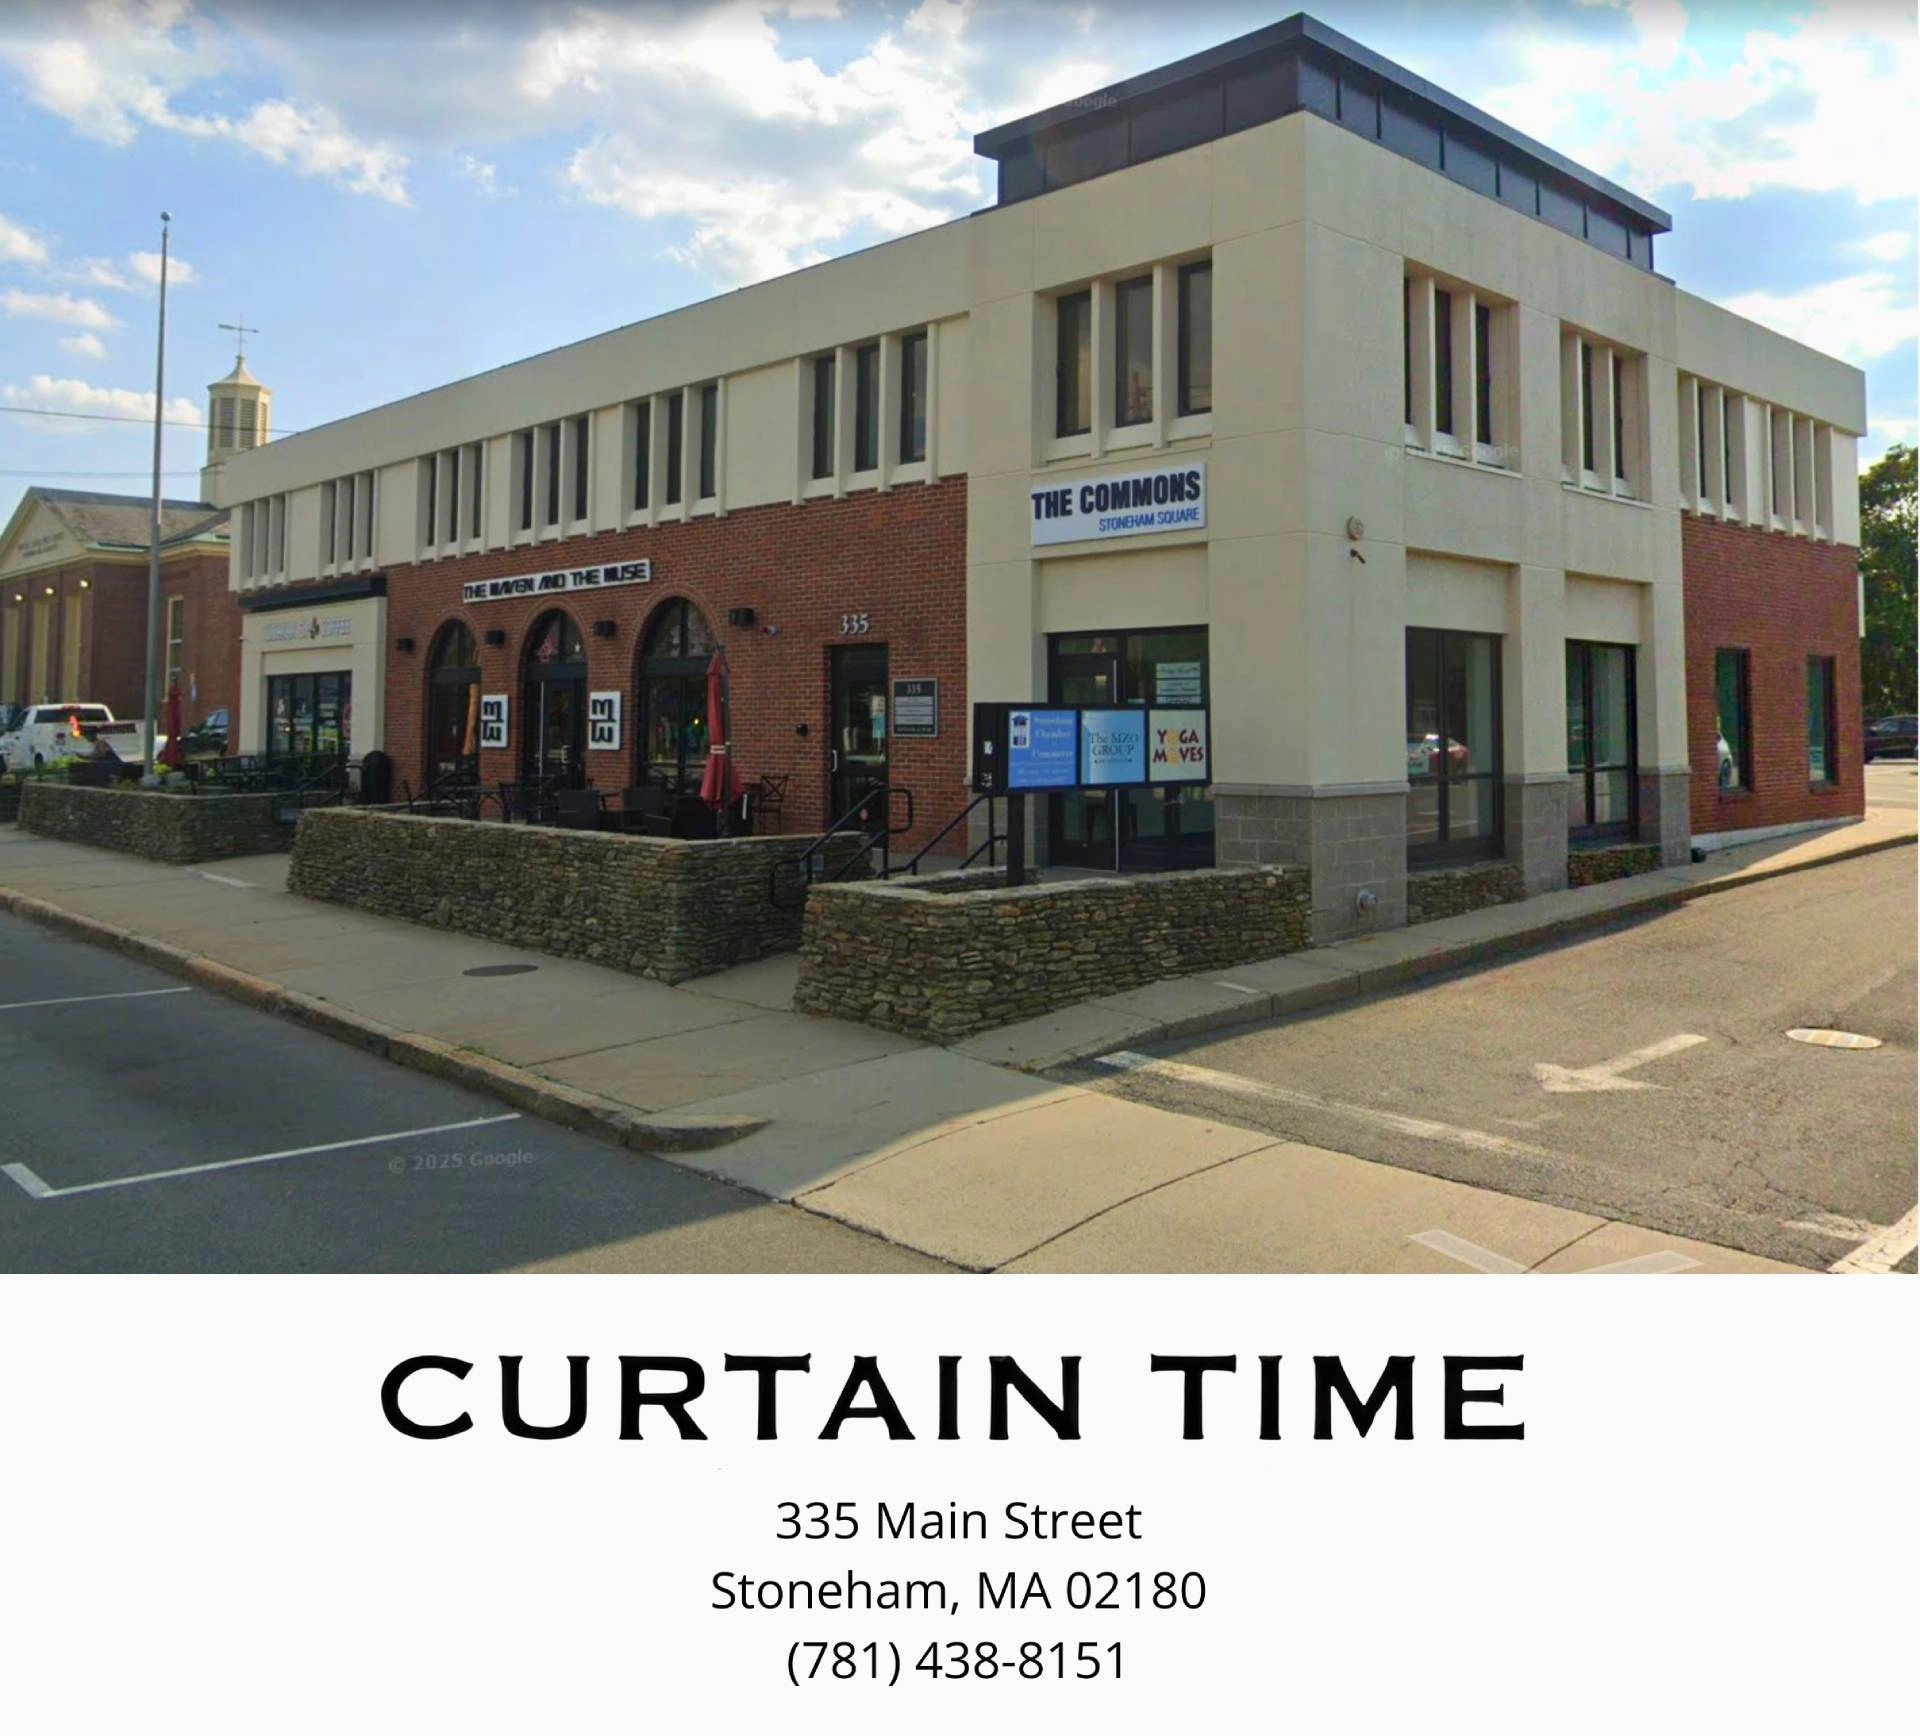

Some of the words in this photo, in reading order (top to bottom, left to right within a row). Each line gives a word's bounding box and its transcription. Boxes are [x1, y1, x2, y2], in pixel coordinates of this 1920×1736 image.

[1031, 488, 1073, 520] THE
[1080, 470, 1201, 515] COMMONS
[1099, 512, 1155, 532] STONEHAM
[1157, 507, 1200, 525] SQUARE
[464, 584, 486, 599] THE
[490, 578, 535, 597] MAVEN
[538, 573, 566, 591] AND
[570, 569, 599, 586] THE
[603, 563, 647, 583] MUSE
[840, 613, 869, 635] 335
[1157, 729, 1200, 745] YOGA
[1092, 744, 1135, 757] GROUP
[1153, 747, 1204, 767] MOVES
